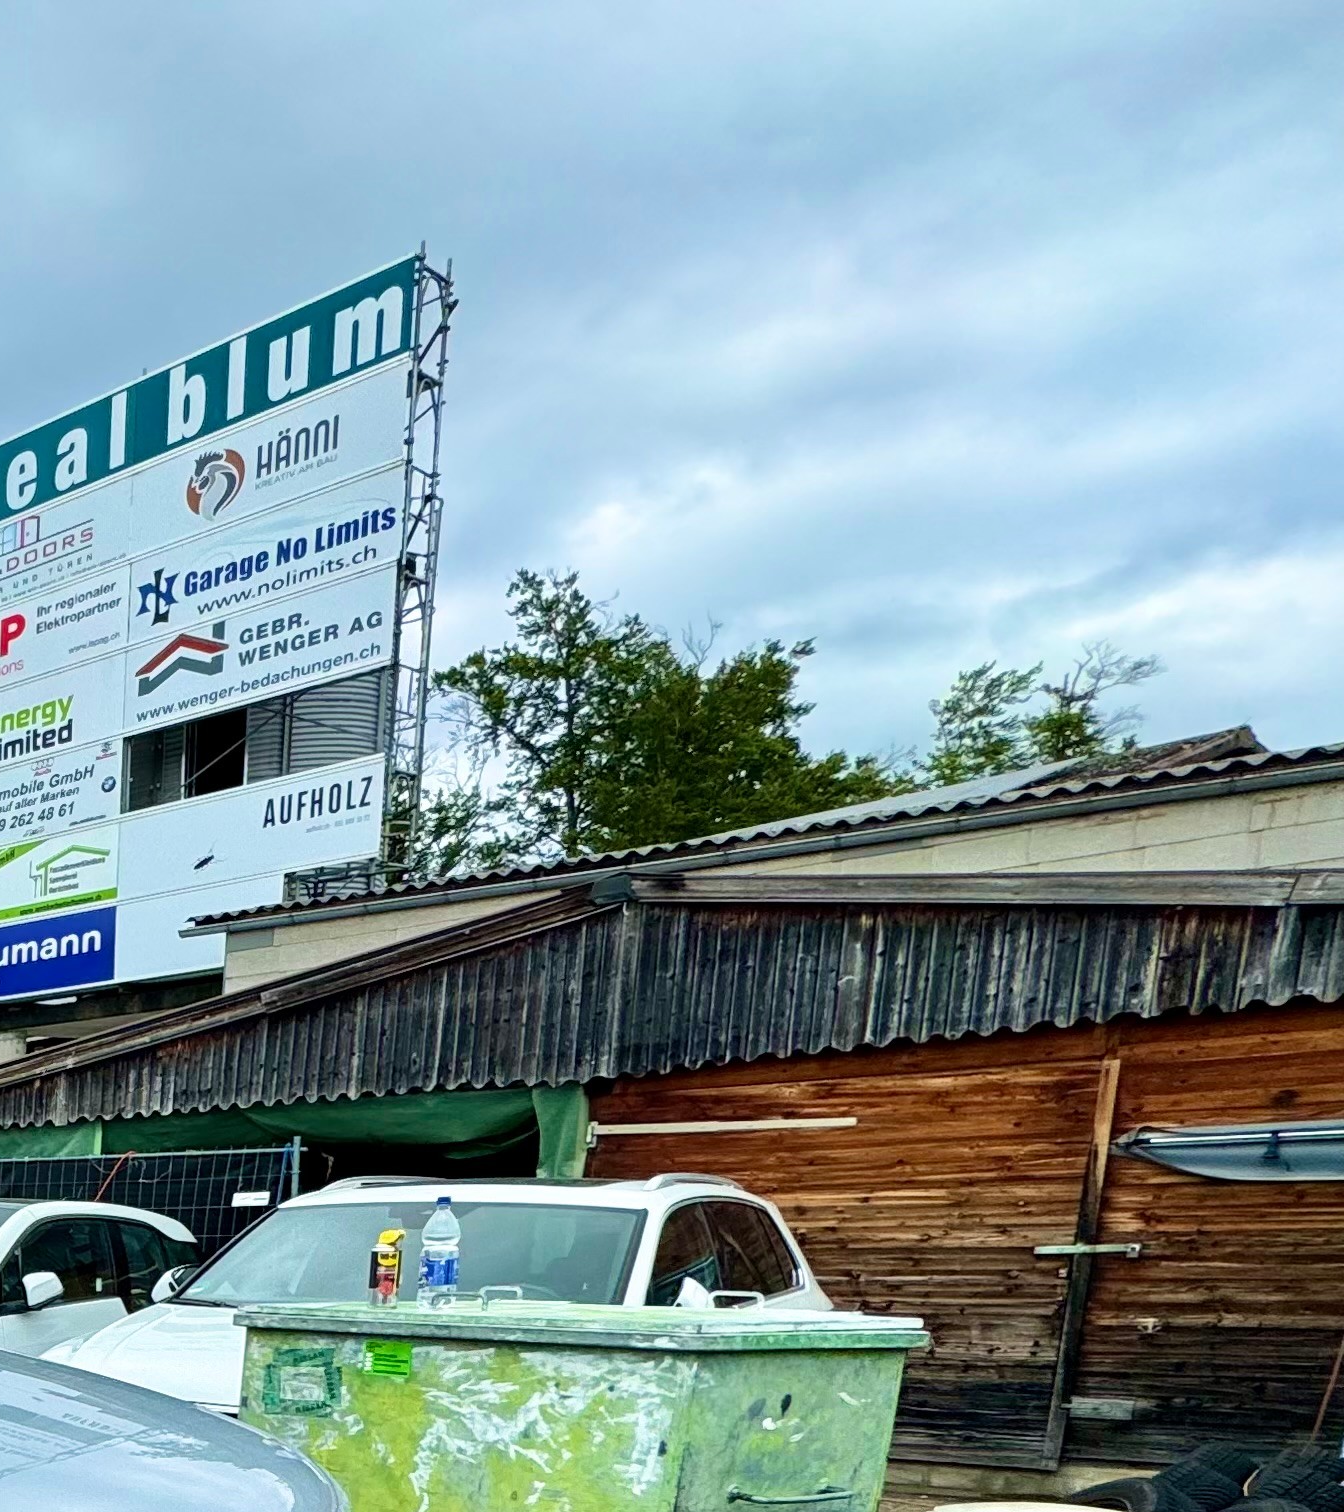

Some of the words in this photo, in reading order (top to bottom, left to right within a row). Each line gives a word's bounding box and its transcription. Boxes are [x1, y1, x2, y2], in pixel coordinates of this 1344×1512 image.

[167, 284, 404, 447] blum
[256, 414, 340, 480] HÄNNI
[184, 550, 270, 598] Garage
[276, 536, 308, 567] No
[315, 506, 397, 554] Limits
[36, 603, 53, 618] Ihr
[55, 582, 117, 612] regionaler
[197, 545, 378, 615] www.nolimits.ch
[36, 597, 122, 635] Elektropartner
[239, 624, 340, 668] WENGER
[348, 611, 383, 636] AG
[240, 612, 310, 645] GEBR.
[136, 642, 382, 723] www.wenger-bedachungen.ch
[14, 797, 37, 811] aller
[40, 786, 80, 805] Marken
[49, 764, 95, 789] GmbH
[263, 775, 374, 829] AUFHOLZ
[9, 811, 34, 830] 262
[37, 806, 54, 822] 48
[58, 801, 75, 819] 61
